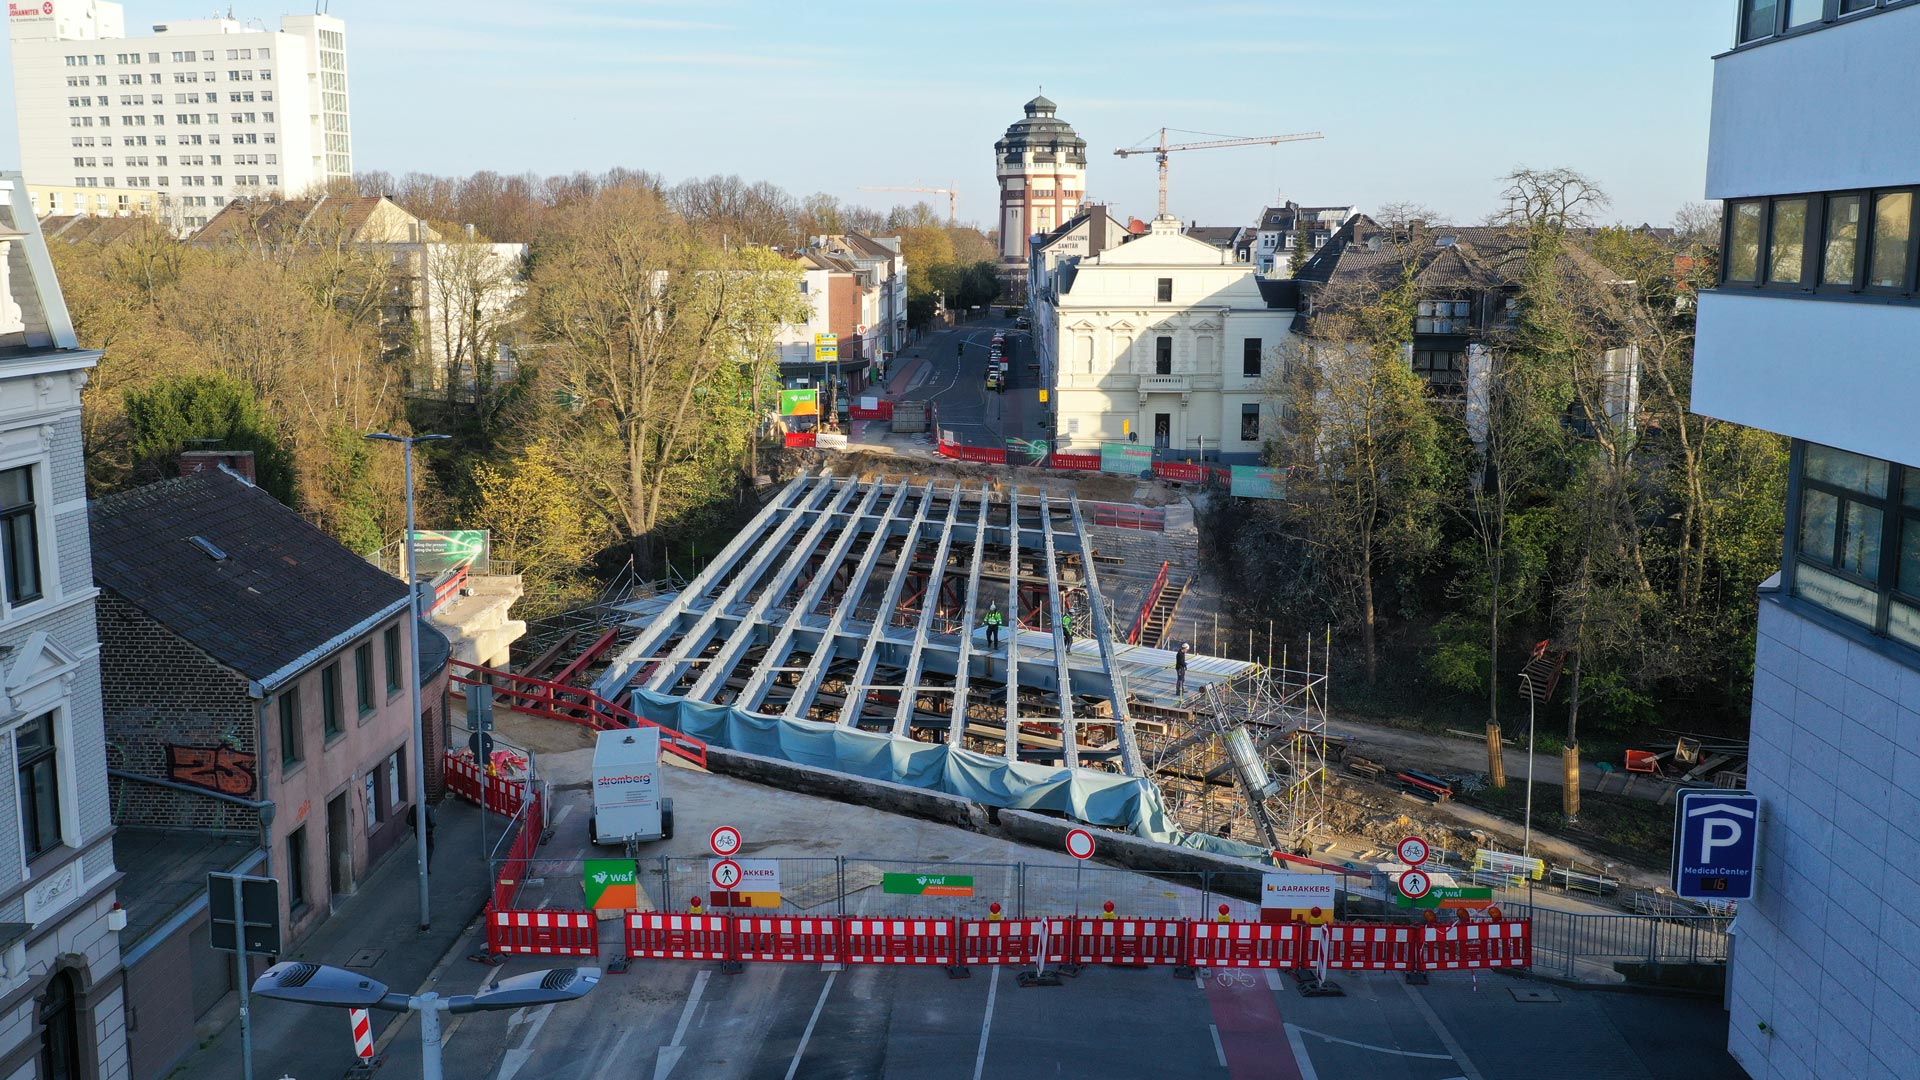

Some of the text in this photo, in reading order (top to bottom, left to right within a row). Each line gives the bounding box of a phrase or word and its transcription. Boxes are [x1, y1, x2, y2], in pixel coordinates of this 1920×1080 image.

[597, 774, 651, 786] stromberg
[1700, 817, 1742, 864] P
[609, 870, 633, 882] w&f
[743, 869, 775, 877] AKKERS
[1684, 866, 1749, 876] Medical Center
[929, 876, 945, 884] w&f
[1713, 878, 1726, 890] 16
[1276, 885, 1331, 893] LAARAKKERS
[1445, 889, 1463, 897] w&f
